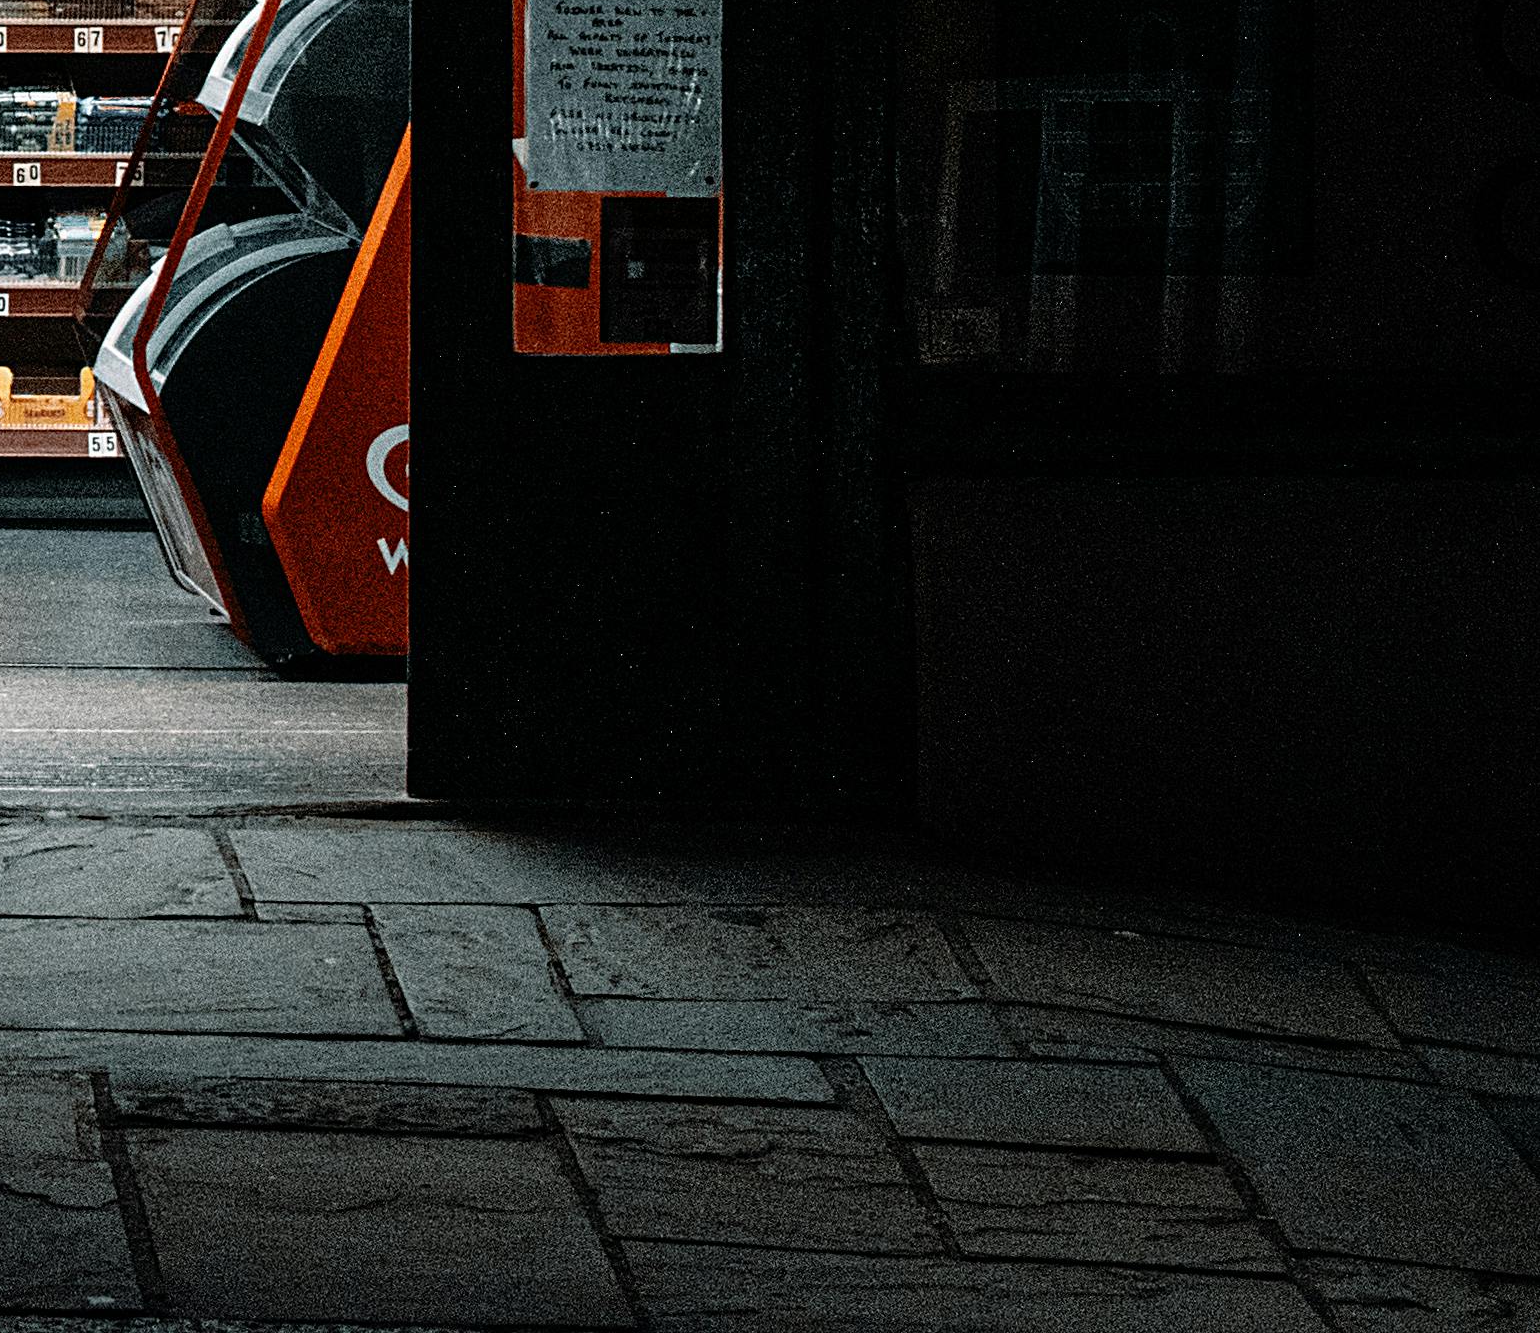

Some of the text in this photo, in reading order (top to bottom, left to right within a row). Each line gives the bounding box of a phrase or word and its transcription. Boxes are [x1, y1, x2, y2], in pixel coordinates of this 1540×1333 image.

[554, 0, 605, 16] JOINER
[614, 5, 643, 17] NEW
[649, 6, 665, 16] TO
[591, 17, 624, 28] AREA
[77, 29, 101, 47] 67
[655, 30, 712, 47] JOINERY
[15, 164, 39, 183] 60
[91, 435, 116, 452] 55
